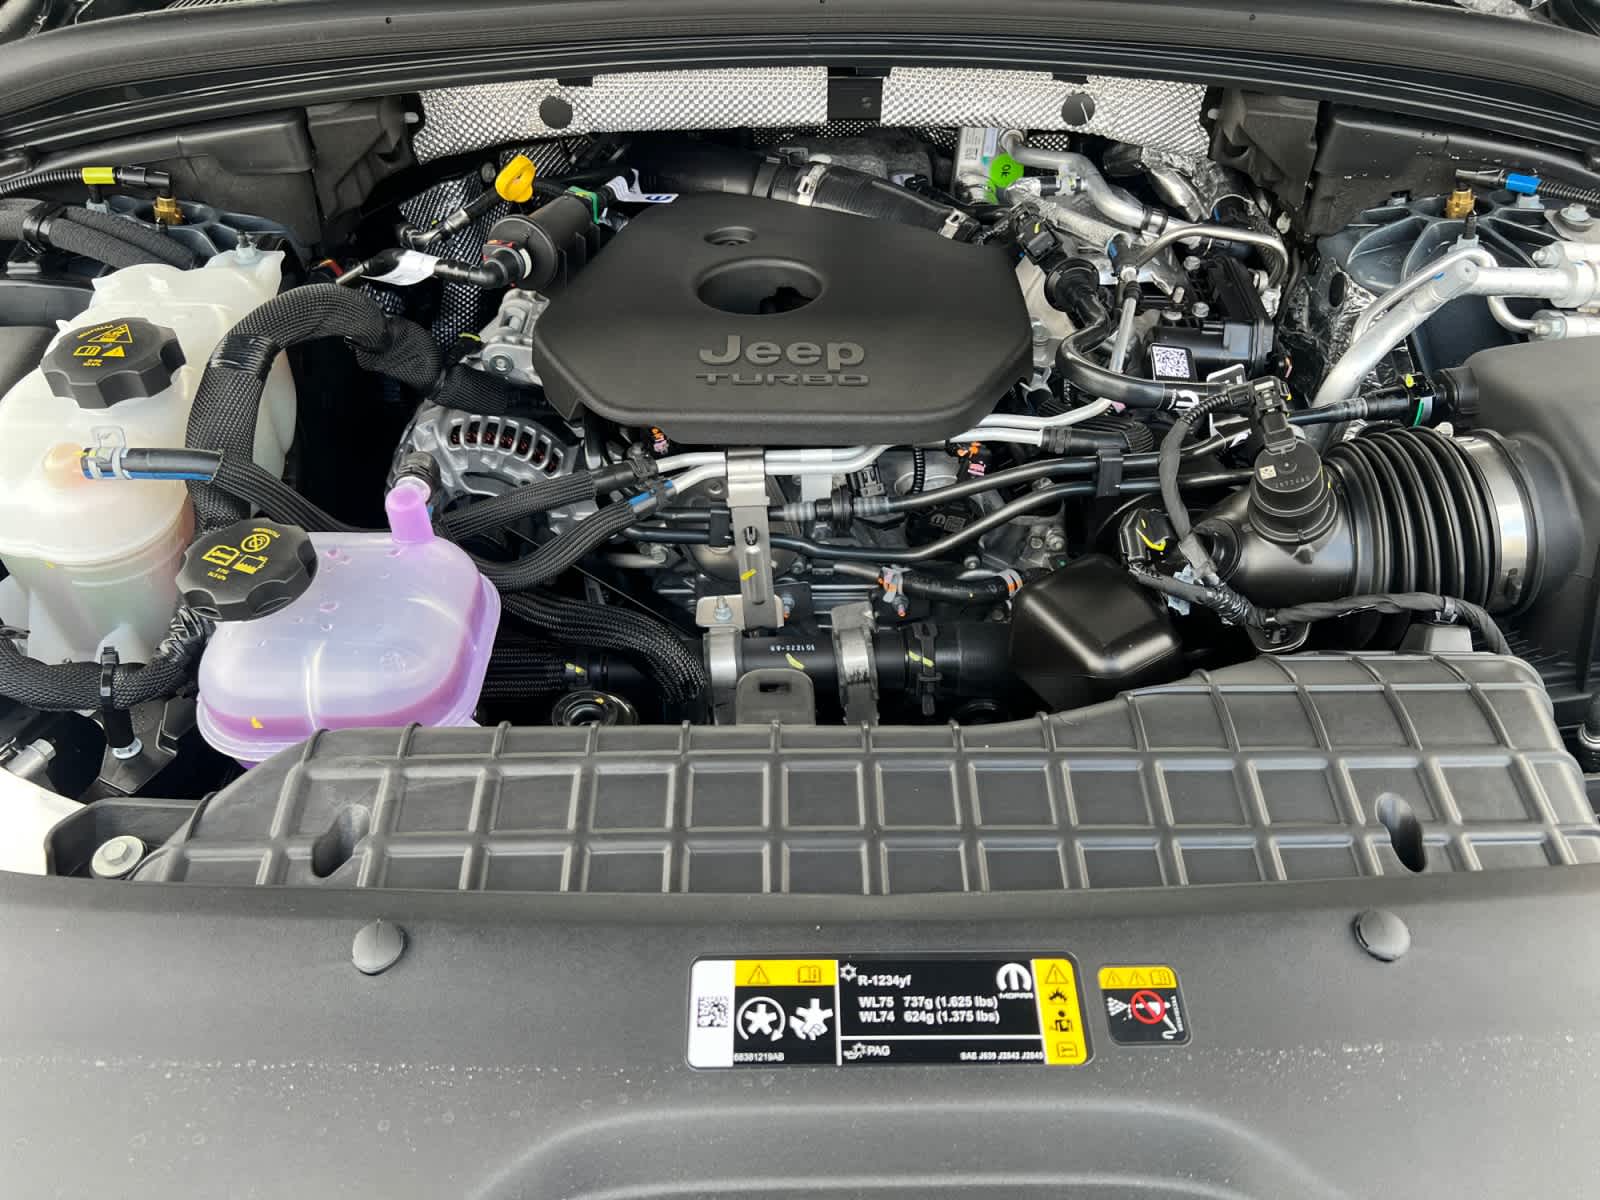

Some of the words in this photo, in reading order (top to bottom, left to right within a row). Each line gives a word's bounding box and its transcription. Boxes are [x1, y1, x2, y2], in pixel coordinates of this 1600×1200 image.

[699, 335, 865, 372] Jeep
[696, 373, 869, 386] TURBO
[857, 974, 912, 989] R-1234yf
[857, 996, 895, 1008] WL75
[902, 996, 934, 1010] 737g
[935, 996, 973, 1010] (1.625
[974, 995, 998, 1010] lbs)
[998, 992, 1034, 1000] MOPAR
[858, 1011, 896, 1023] WL74
[903, 1010, 935, 1025] 624g
[936, 1010, 975, 1025] (1.375
[975, 1010, 1000, 1025] lbs)
[866, 1045, 891, 1057] PAG
